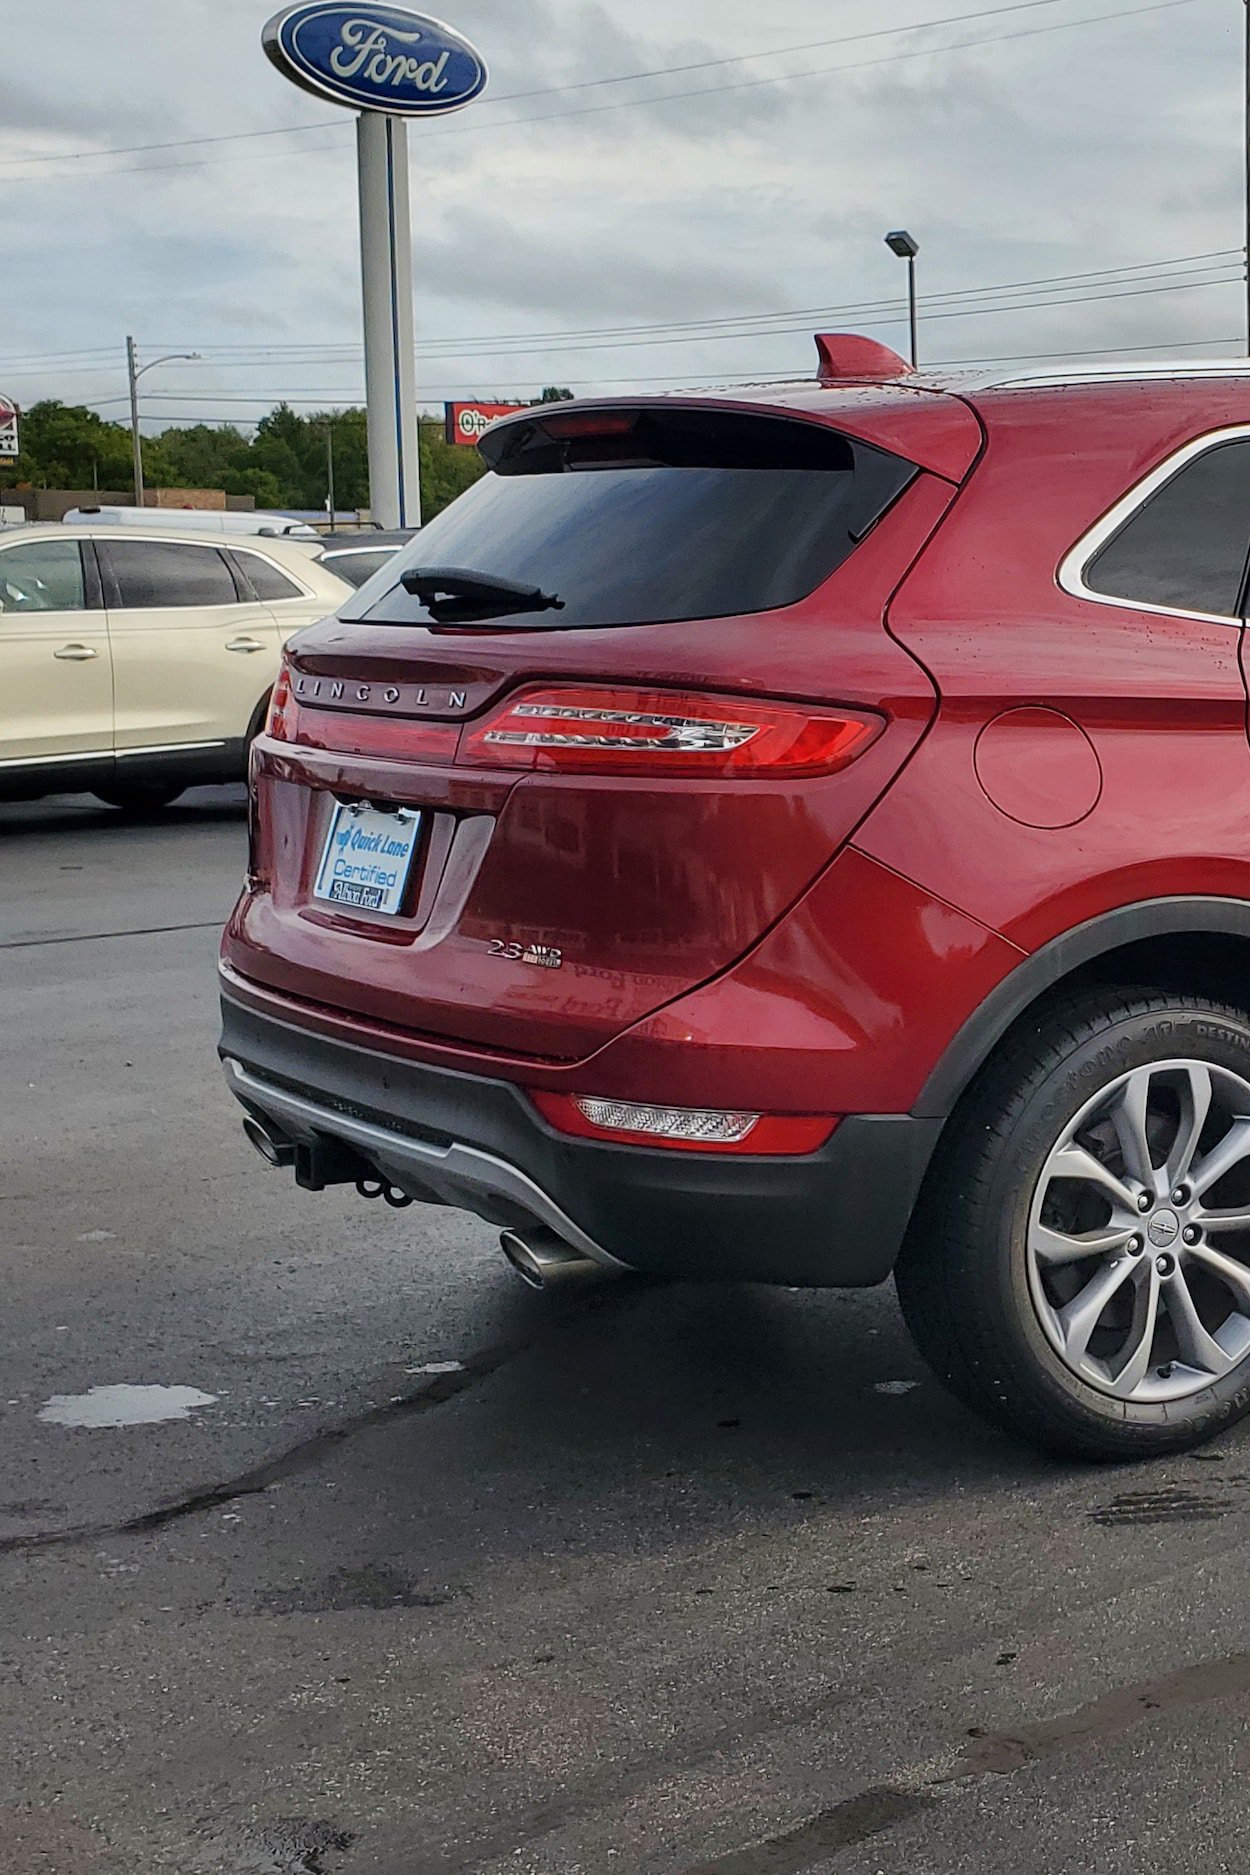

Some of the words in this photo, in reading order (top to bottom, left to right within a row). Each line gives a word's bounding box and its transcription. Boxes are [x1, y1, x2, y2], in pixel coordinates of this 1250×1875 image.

[330, 18, 450, 93] Ford
[296, 679, 467, 708] LINCOLN
[350, 828, 383, 853] Quick
[380, 834, 409, 858] Lane
[333, 858, 398, 887] Certified
[526, 944, 562, 957] AWD
